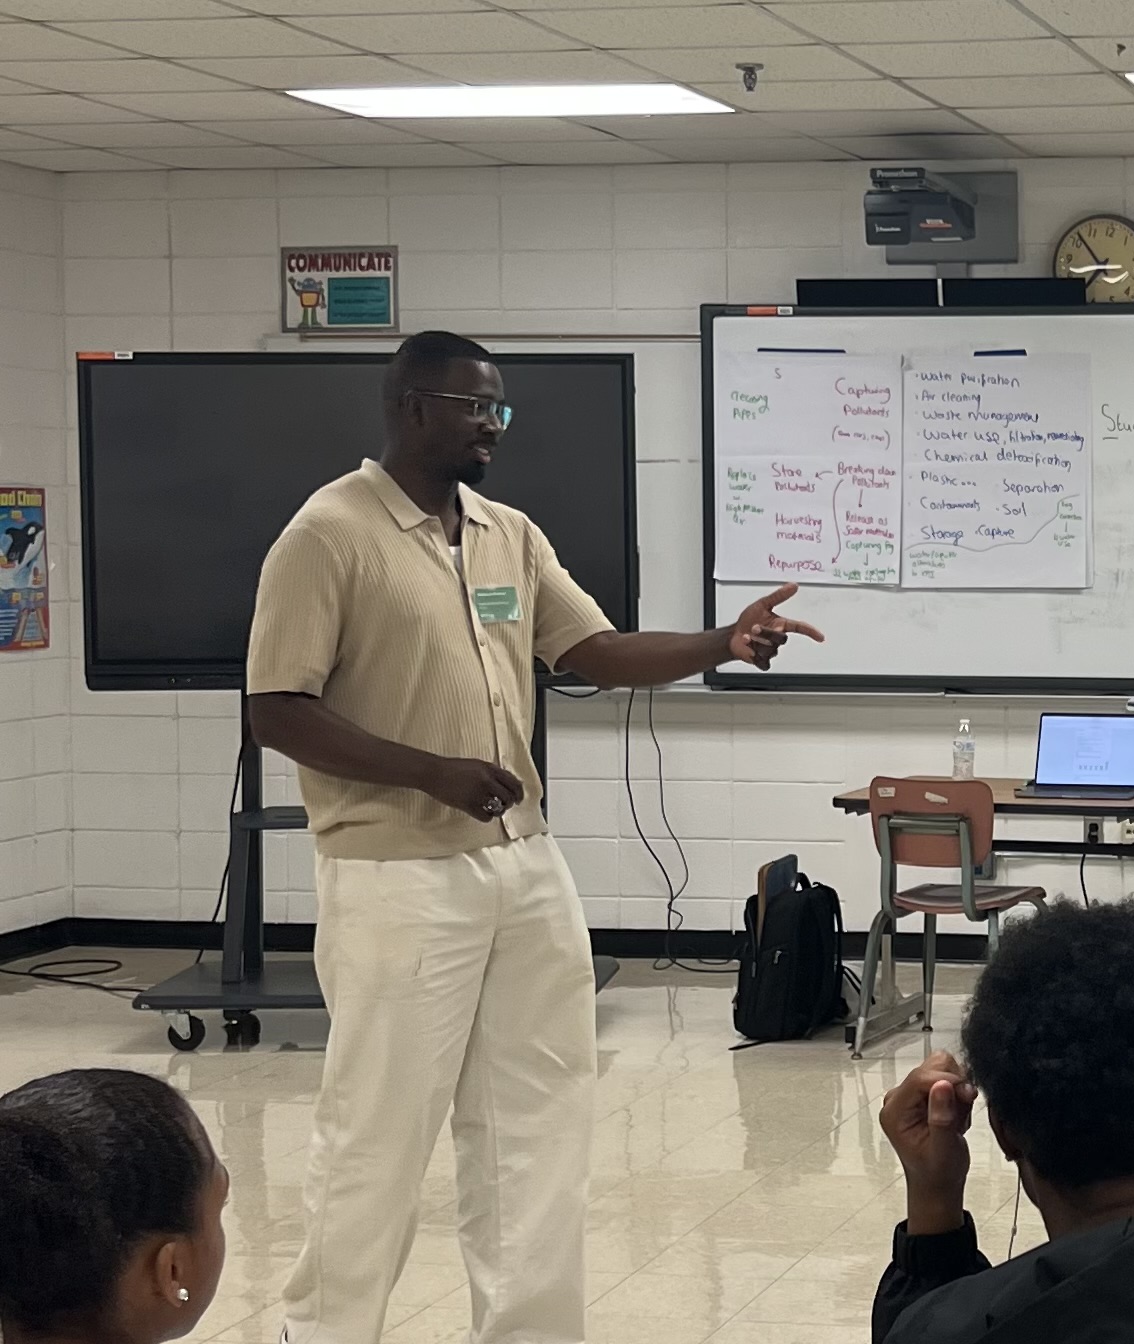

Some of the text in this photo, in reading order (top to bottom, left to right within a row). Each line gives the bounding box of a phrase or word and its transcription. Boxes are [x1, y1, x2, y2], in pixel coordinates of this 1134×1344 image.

[1105, 224, 1115, 238] 12
[287, 252, 392, 273] COMMUNICATE
[835, 377, 891, 405] Capturing
[942, 392, 981, 410] cleaning
[922, 409, 961, 421] Waste
[925, 448, 988, 464] Chemical
[1003, 479, 1064, 496] Separation
[775, 512, 822, 533] Harvesting
[977, 524, 1015, 538] Capture
[921, 526, 964, 546] Storage
[768, 554, 825, 574] Repurpose
